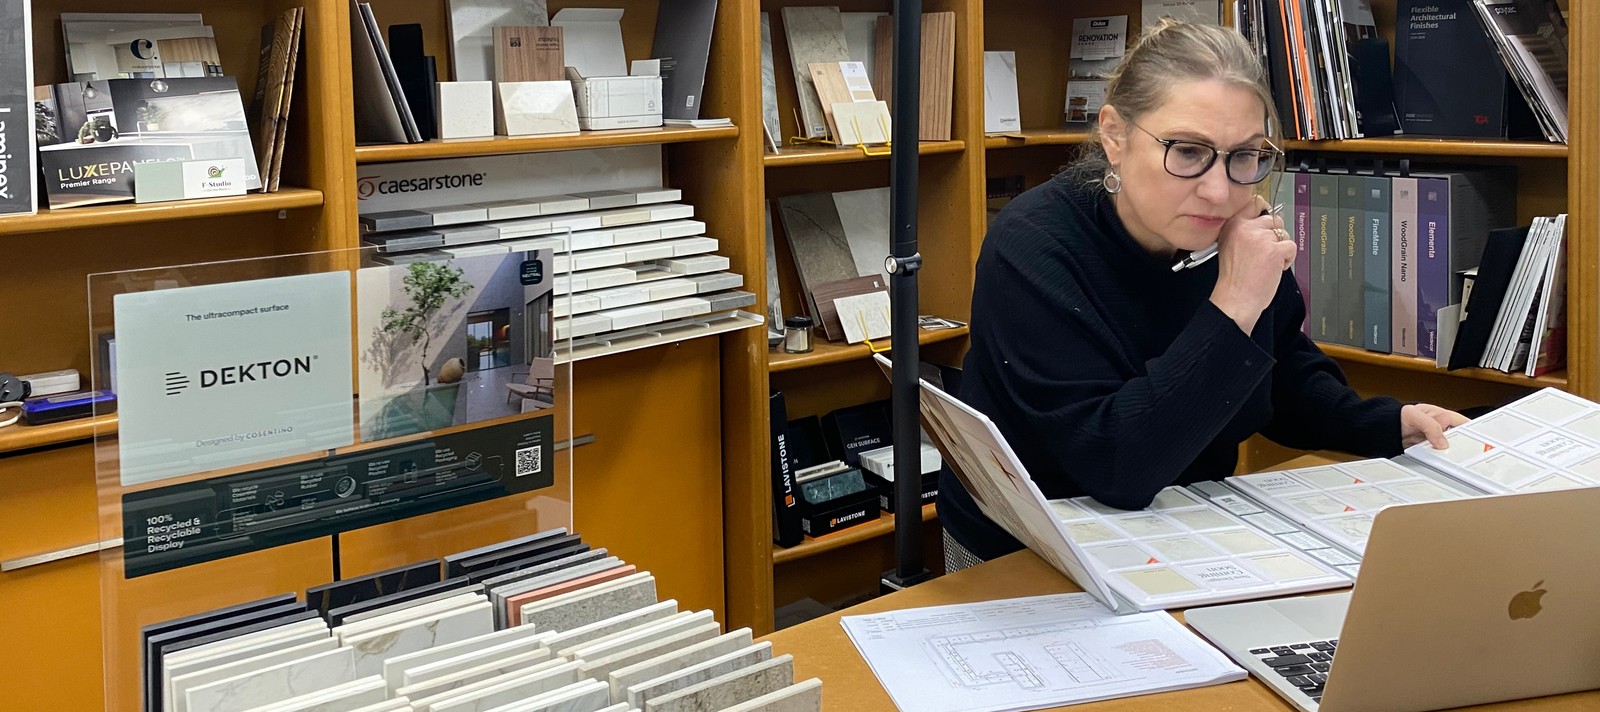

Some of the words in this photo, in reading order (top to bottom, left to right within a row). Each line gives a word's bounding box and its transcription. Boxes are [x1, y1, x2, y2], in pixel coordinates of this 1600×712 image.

[1411, 13, 1456, 21] Architectural
[1078, 34, 1119, 42] RENOVATION
[60, 180, 91, 189] Premier
[92, 177, 117, 185] Range
[1372, 218, 1380, 256] FineMatte
[1400, 220, 1408, 261] WoodGrain
[1428, 221, 1436, 258] Elementa
[1400, 262, 1408, 282] Nano
[185, 314, 202, 322] The
[203, 307, 258, 320] ultracompact
[259, 304, 290, 313] surface
[196, 434, 234, 448] Designed
[234, 433, 245, 442] by
[245, 426, 293, 439] COSENTINO
[777, 433, 792, 494] LAVISTONE
[146, 514, 173, 526] 100%
[147, 519, 192, 535] Recycled
[193, 517, 201, 526] &
[837, 510, 866, 524] LAVISTONE
[147, 527, 202, 544] Recyclable
[147, 540, 184, 553] Display
